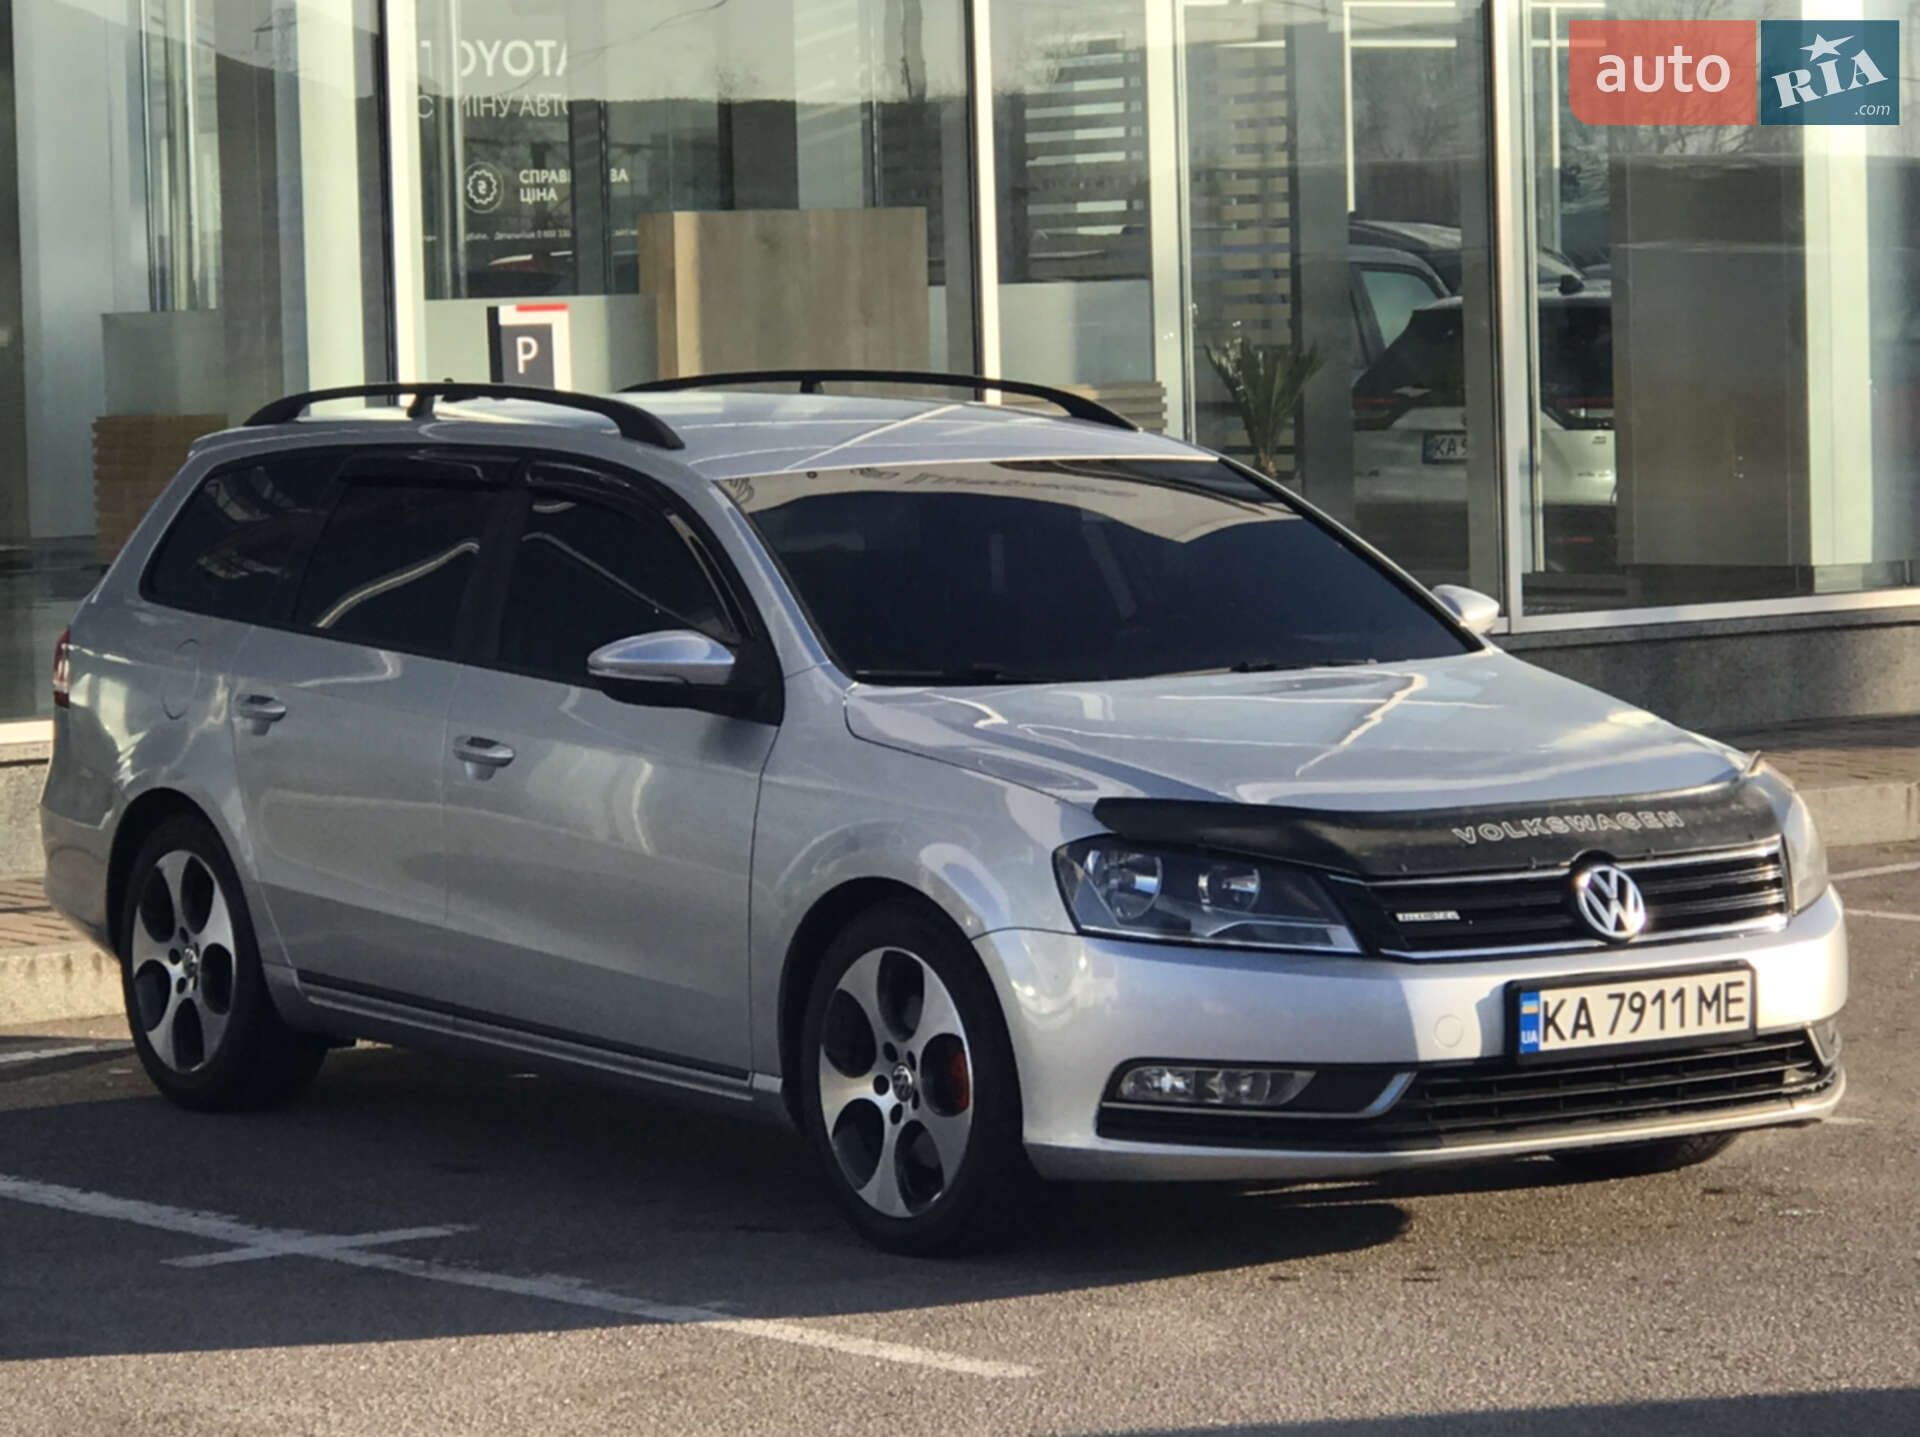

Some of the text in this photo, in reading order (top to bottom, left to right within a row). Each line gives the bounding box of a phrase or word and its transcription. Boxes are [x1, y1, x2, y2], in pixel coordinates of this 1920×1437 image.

[520, 187, 558, 204] ЦІНА
[516, 336, 538, 374] P
[1452, 810, 1685, 844] VOLKSWAGEN
[1542, 980, 1746, 1043] KA 7911 ME
[1521, 1030, 1539, 1044] UA
